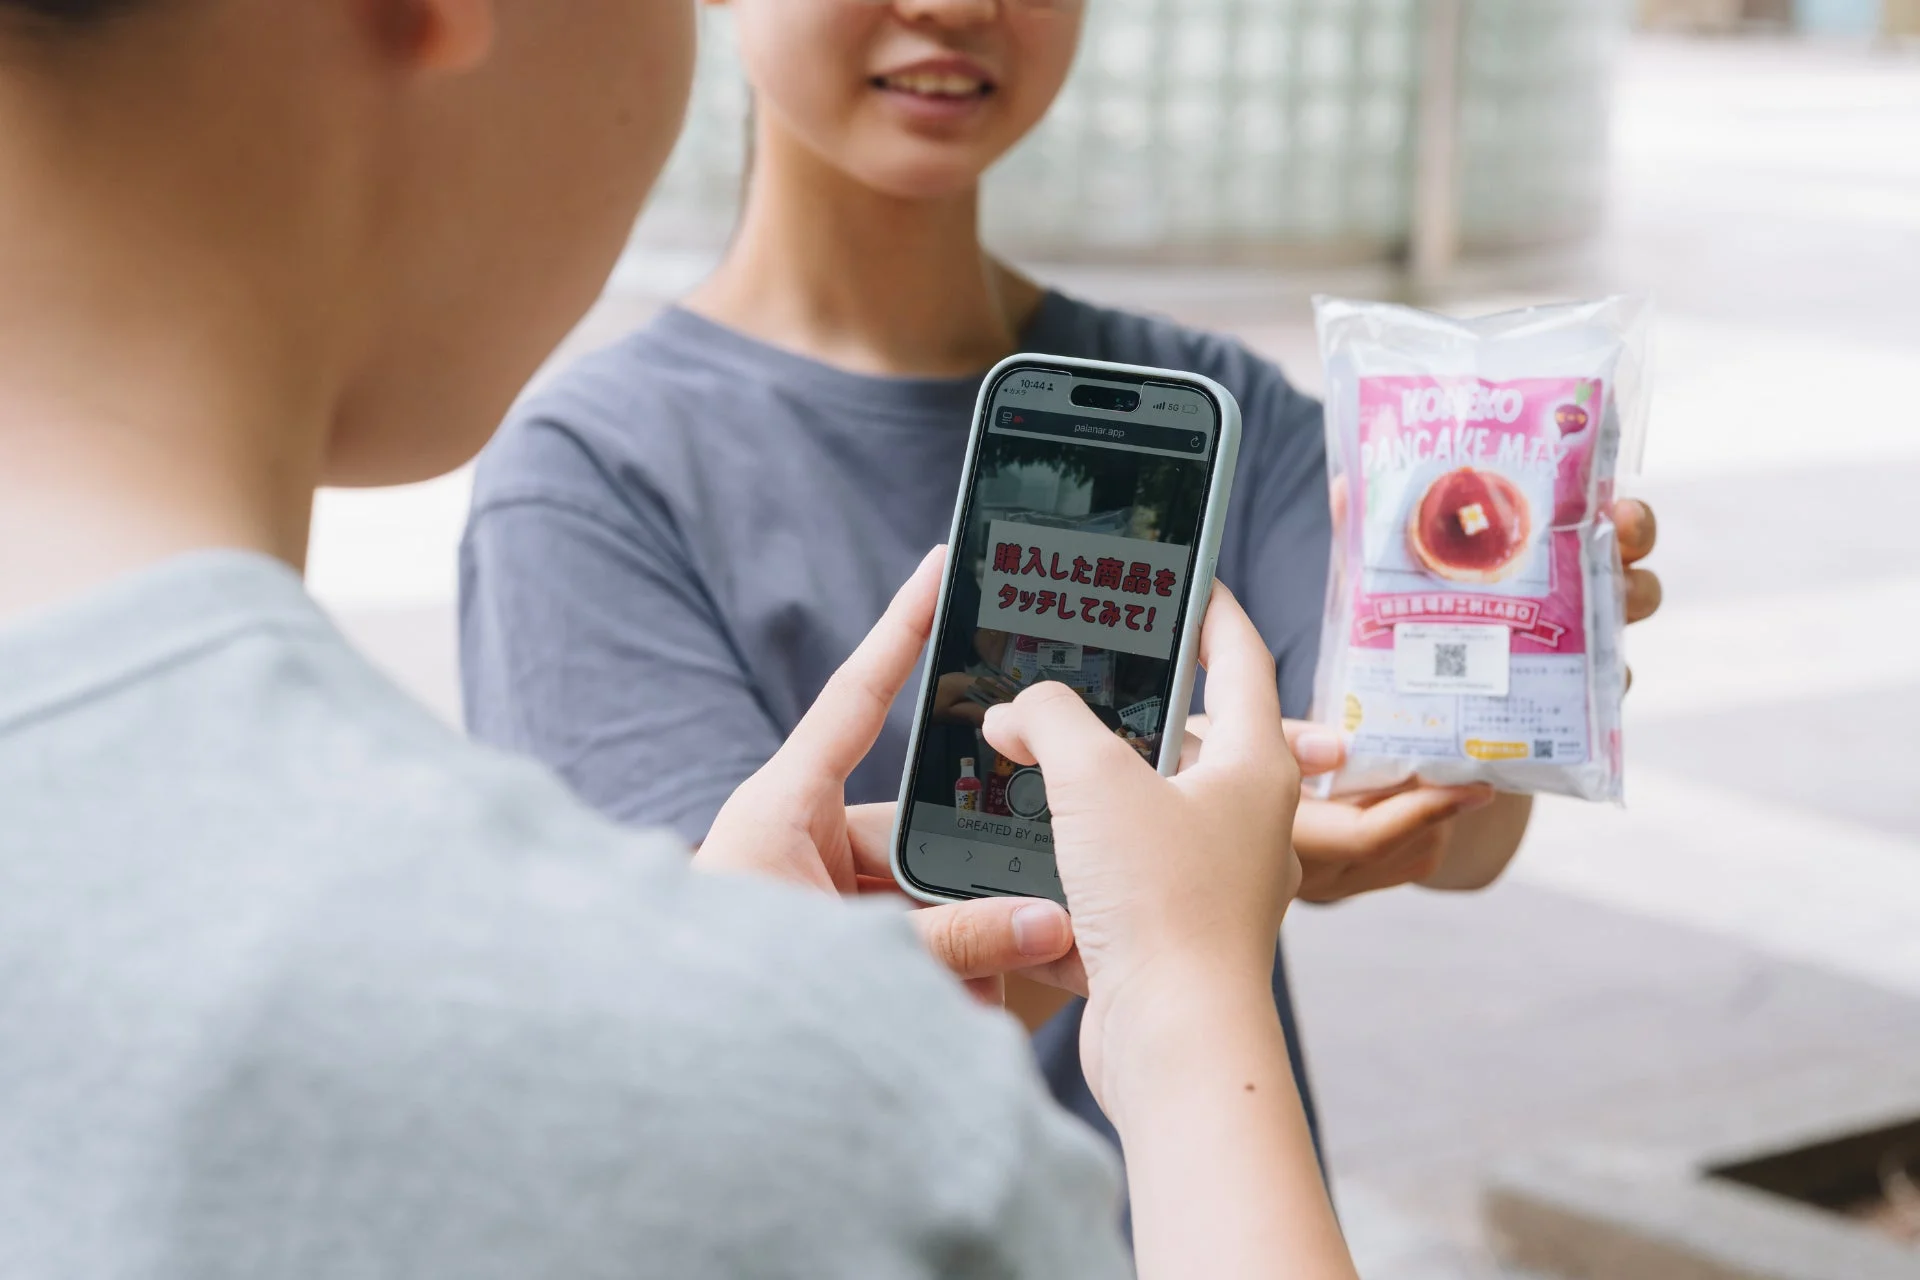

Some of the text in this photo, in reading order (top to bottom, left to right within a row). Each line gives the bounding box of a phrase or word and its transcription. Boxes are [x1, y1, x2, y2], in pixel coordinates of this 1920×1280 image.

[1021, 379, 1045, 390] 10:44
[1167, 403, 1179, 412] 5G
[1074, 422, 1125, 439] palanar.app
[993, 542, 1177, 597] 購入した商品を
[957, 817, 1012, 837] CREATED
[1015, 827, 1032, 840] BY
